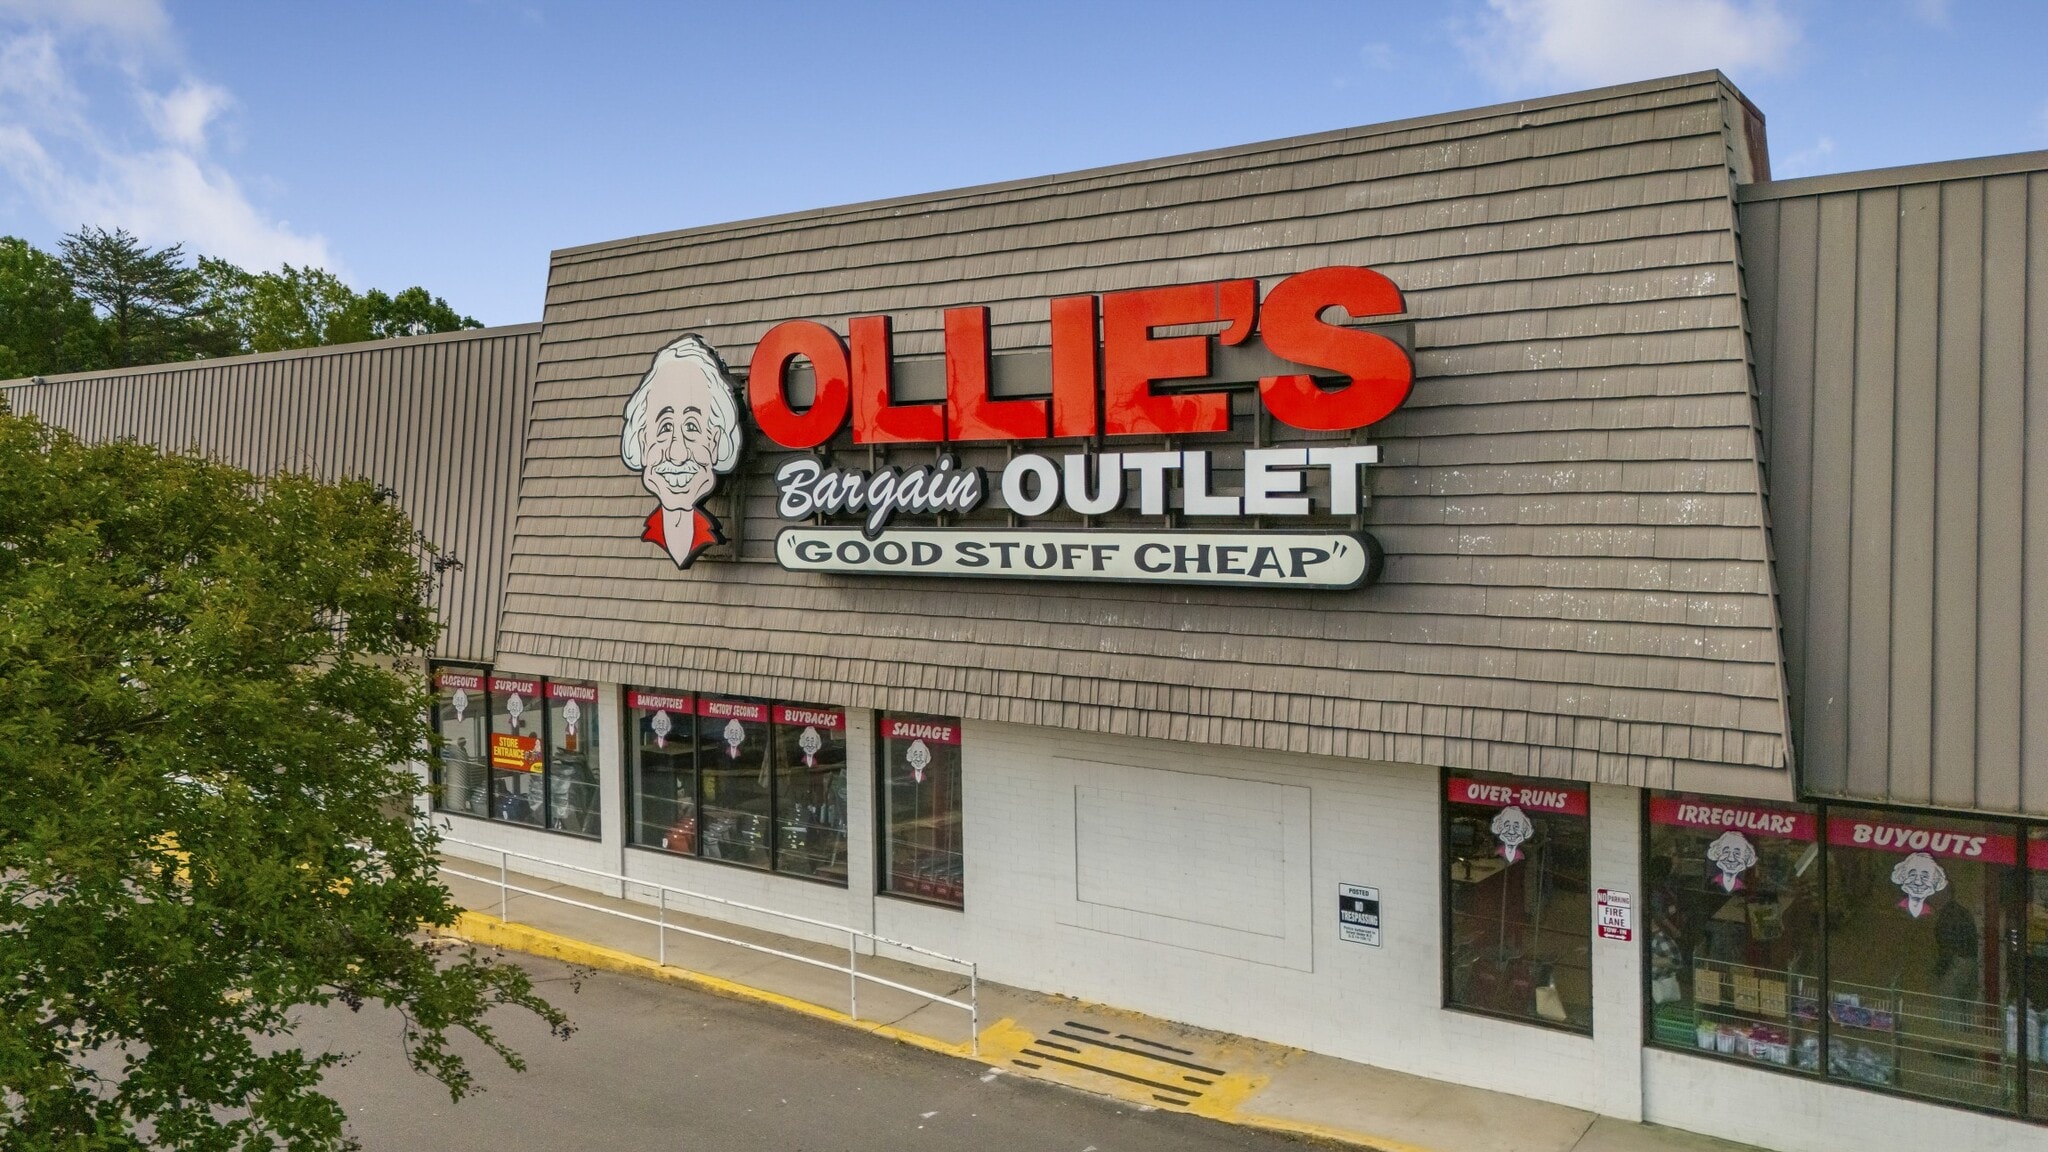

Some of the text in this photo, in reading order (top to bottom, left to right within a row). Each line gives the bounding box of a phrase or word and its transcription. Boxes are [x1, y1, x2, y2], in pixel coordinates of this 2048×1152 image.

[749, 266, 1414, 448] OLLIE'S
[777, 445, 1378, 530] Bargain OUTLET
[787, 535, 1348, 578] "GOOD STUFF CHEAP"
[441, 675, 477, 688] CLOSEOUTS
[495, 680, 533, 693] SURPLUS
[553, 684, 595, 700] LIQUIDATIONS
[637, 694, 683, 710] BANKRUPTCIES
[709, 702, 758, 718] FACTORY SECONDS
[785, 709, 837, 726] BUYBACKS
[892, 722, 951, 741] SALVAGE
[499, 736, 519, 749] STORE
[493, 745, 525, 760] ENTRANCE
[1467, 783, 1568, 809] OVER-RUNS
[1677, 804, 1796, 834] IRREGULARS
[1852, 824, 1987, 857] BUYOUTS
[1349, 888, 1369, 896] POSTED
[1598, 892, 1629, 904] NO PARKING
[1355, 901, 1363, 912] NO
[1605, 907, 1623, 917] FIRE
[1341, 910, 1378, 926] TRESPASSING
[1603, 917, 1625, 927] LANE
